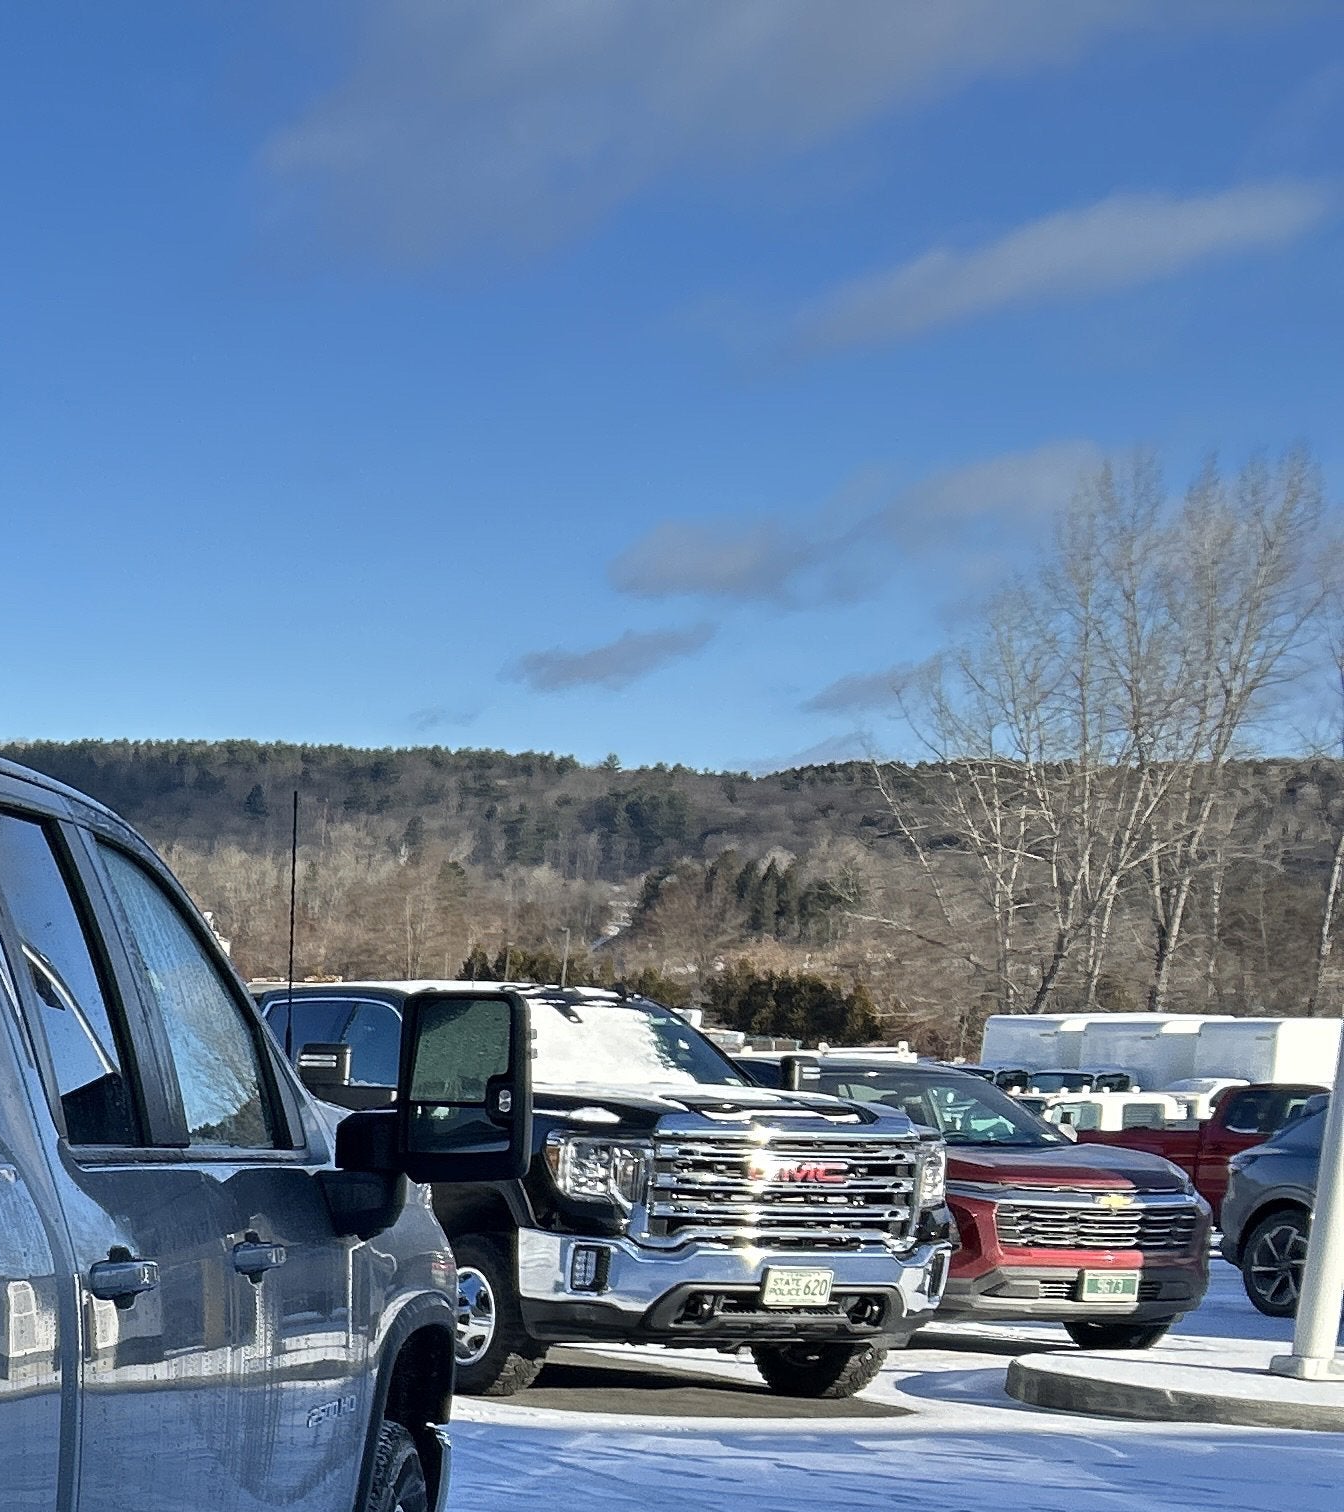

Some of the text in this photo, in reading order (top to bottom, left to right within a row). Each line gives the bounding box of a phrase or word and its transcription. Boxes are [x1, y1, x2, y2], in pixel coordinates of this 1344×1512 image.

[773, 1278, 802, 1286] STATE
[769, 1287, 801, 1296] POLICE
[803, 1279, 828, 1296] 620
